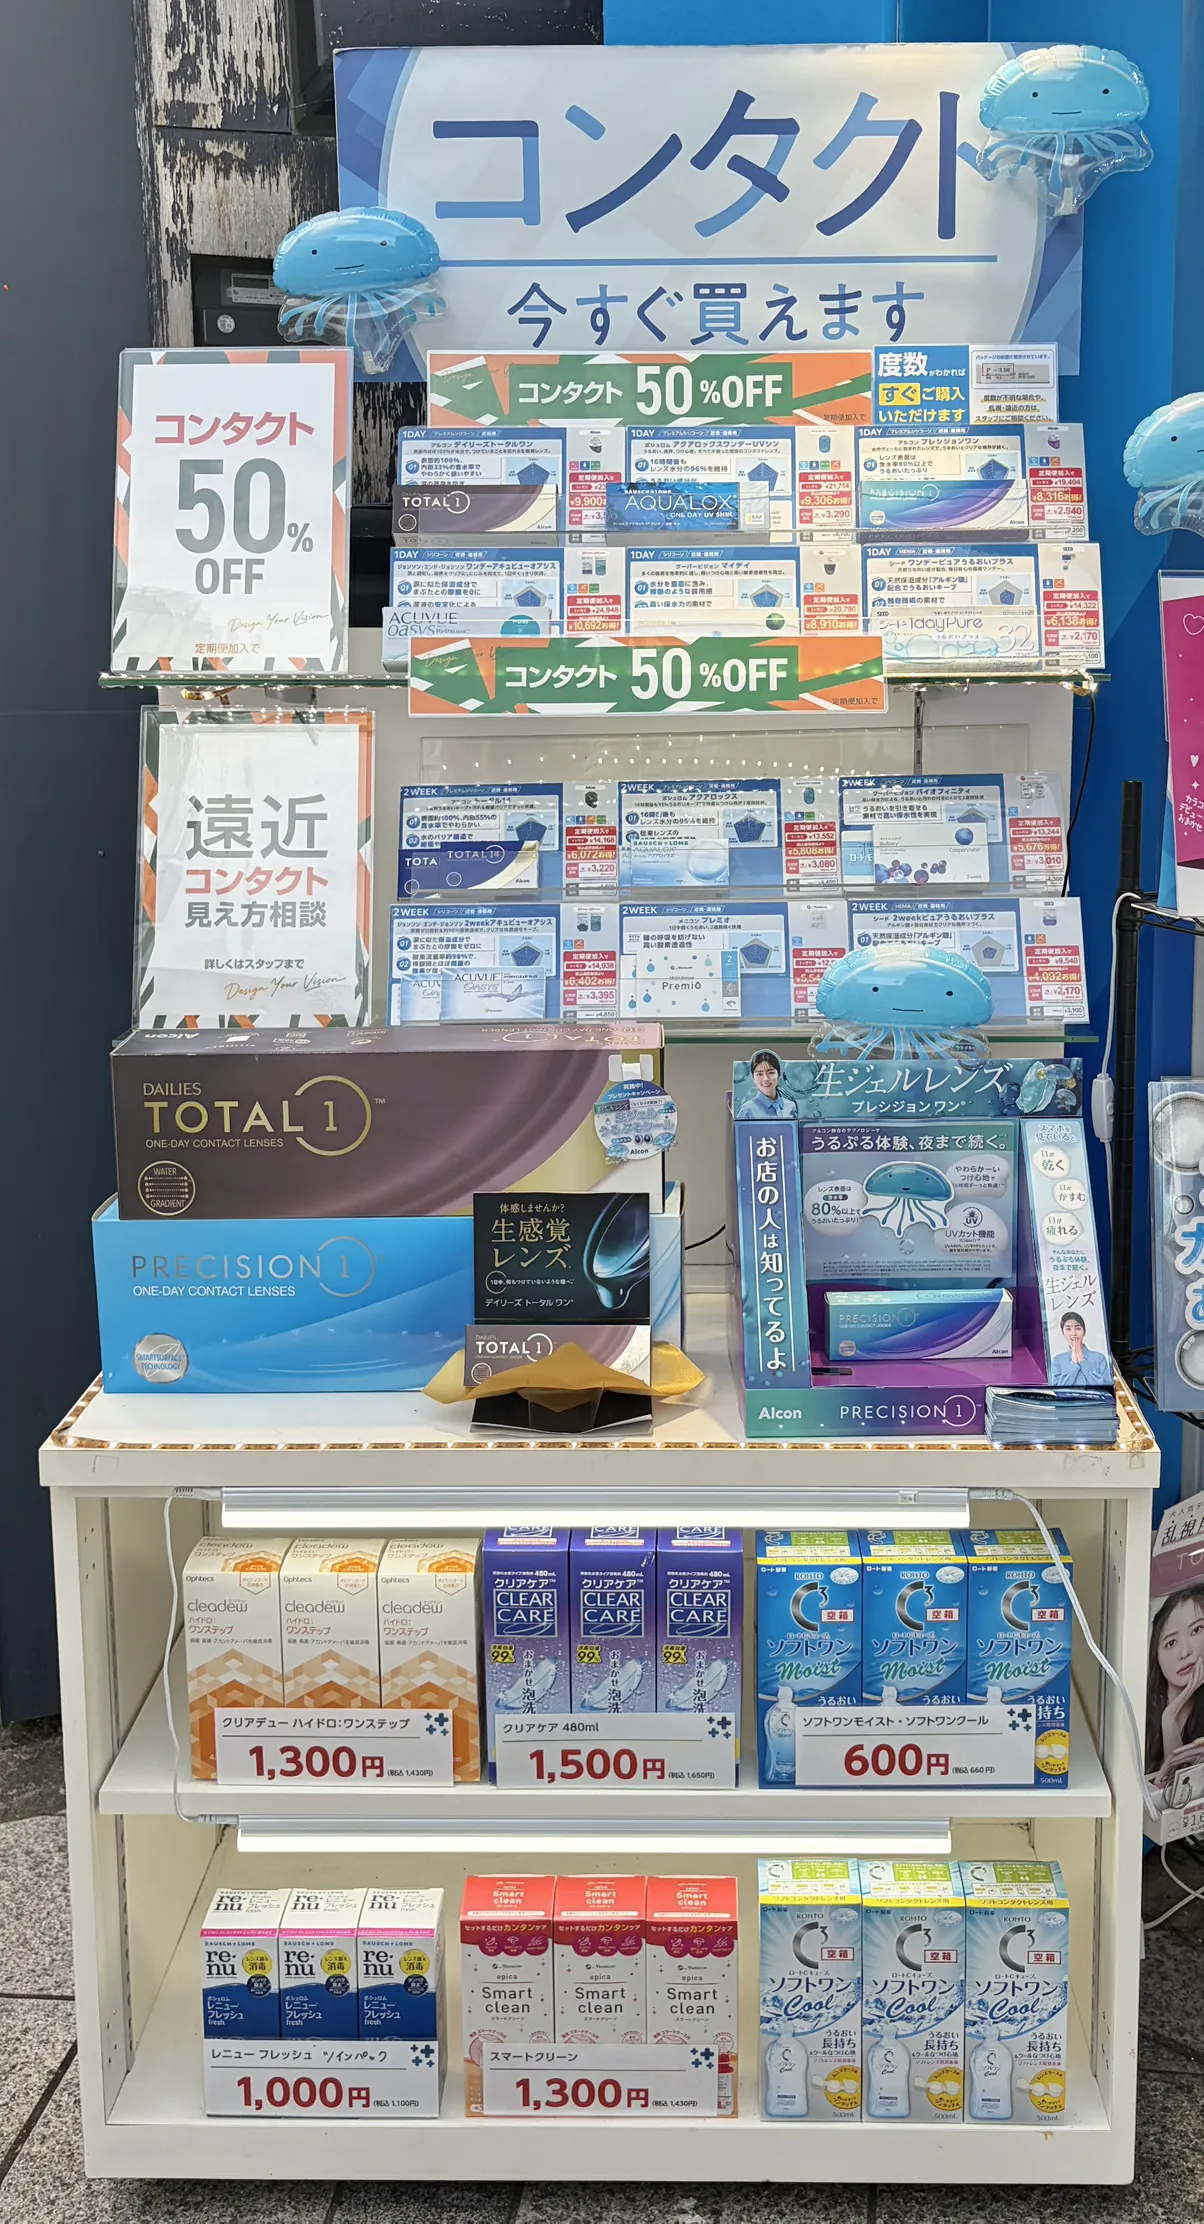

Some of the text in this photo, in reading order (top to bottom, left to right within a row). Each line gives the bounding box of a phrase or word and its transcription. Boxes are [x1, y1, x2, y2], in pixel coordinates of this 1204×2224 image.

[432, 89, 981, 240] コンタクト
[505, 280, 927, 346] 今すぐ買えます
[518, 379, 623, 405] コンタクト
[882, 385, 965, 402] すぐご購入
[878, 409, 965, 423] いただけます
[154, 411, 315, 446] コンタクト
[402, 430, 426, 438] 1DAY
[631, 429, 655, 437] 1DAY
[859, 428, 882, 436] 1DAY
[625, 495, 732, 510] AQUALOX
[394, 550, 419, 558] 1DAY
[630, 551, 654, 559] 1DAY
[867, 548, 891, 556] 1DAY
[908, 558, 1014, 566] ワンデーピュアうるおいプラス
[195, 557, 266, 595] OFF
[227, 610, 329, 633] Design Your Vision
[389, 612, 458, 624] ACUVUE
[999, 623, 1035, 653] 32
[194, 643, 260, 654] 定期便加入で
[505, 664, 617, 690] コンタクト
[404, 787, 437, 796] 2WEEK
[185, 793, 329, 860] 遠近
[185, 866, 329, 897] コンタクト
[393, 908, 429, 916] 2WEEK
[622, 906, 657, 914] 2WEEK
[852, 903, 888, 911] 2WEEK
[184, 901, 327, 929] 見え方相談
[893, 913, 995, 922] 2weekピュアうるおいプラス
[204, 958, 305, 970] 詳しくはスタッフまで
[454, 973, 500, 982] ACUVUE
[224, 974, 347, 1001] Design Your Vision
[811, 1061, 1013, 1099] 生ジェルレンズ
[143, 1082, 202, 1097] DAILIES
[851, 1101, 961, 1114] プレシジョン ワン
[143, 1101, 338, 1134] TOTAL 1
[1039, 1124, 1070, 1133] スマホを
[145, 1138, 284, 1148] ONE-DAY CONTACT LENSES
[811, 1134, 1007, 1151] うるぷる体験、夜まで続く。
[1036, 1132, 1077, 1142] 見ていると
[153, 1167, 177, 1176] WATER
[1041, 1159, 1066, 1171] 乾く
[150, 1199, 185, 1208] GRADIENT
[1059, 1192, 1086, 1202] かすむ
[499, 1203, 565, 1213] 体感しませんか?
[811, 1216, 860, 1225] うるおいたっぷり!
[491, 1218, 571, 1243] 生感覚
[945, 1229, 996, 1239] UVカット機能
[1046, 1225, 1079, 1237] 疲れる
[493, 1243, 572, 1269] レンズ
[756, 1136, 787, 1370] お店の人は知ってるよ
[131, 1255, 349, 1279] PRECISION 1
[133, 1285, 296, 1297] ONE-DAY CONTACT LENSES
[1045, 1275, 1097, 1295] 生ジェル
[485, 1298, 522, 1307] デイリーズ
[525, 1298, 553, 1307] トータル
[1051, 1290, 1097, 1311] レンズ
[758, 1406, 802, 1420] Alcon
[840, 1404, 947, 1420] PRECISION
[185, 1575, 215, 1583] Ophtecs
[494, 1578, 549, 1589] クリアケア
[496, 1592, 553, 1606] CLEAR
[583, 1592, 640, 1606] CLEAR
[187, 1601, 248, 1613] cleadew
[497, 1609, 553, 1622] CARE
[584, 1609, 640, 1622] CARE
[825, 1610, 850, 1620] 空箱
[189, 1625, 234, 1636] ワンステップ
[768, 1639, 853, 1656] ソフトワン
[872, 1639, 957, 1656] ソフトワン
[977, 1638, 1062, 1655] ソフトワン
[777, 1659, 840, 1680] Moist
[881, 1659, 944, 1680] Moist
[986, 1659, 1050, 1680] Moist
[222, 1717, 411, 1730] クリアデュー ハイドロ:ワンステップ
[503, 1722, 599, 1733] クリアケア 480ml
[803, 1715, 989, 1727] ソフトワンモイスト・ソフトワンクール
[248, 1744, 384, 1780] 1,300円
[405, 1769, 434, 1777] 1,430円)
[529, 1748, 666, 1784] 1,500円
[844, 1743, 949, 1776] 600円
[827, 1949, 848, 1960] 空箱
[206, 1963, 237, 1976] nu
[248, 1962, 267, 1971] 消毒
[770, 1977, 852, 1992] ソフトワン
[873, 1978, 955, 1994] ソフトワン
[976, 1980, 1058, 1996] ソフトワン
[482, 1987, 533, 1999] Smart
[485, 2001, 530, 2014] clean
[578, 2001, 623, 2014] clean
[784, 1995, 834, 2018] Cool
[886, 1997, 936, 2020] Cool
[989, 1998, 1039, 2020] Cool
[826, 2030, 856, 2038] うるおい
[822, 2038, 856, 2049] 長持ち
[211, 2050, 388, 2063] レニュー フレッシュ ツインパック
[490, 2052, 578, 2062] スマートクリーン
[236, 2076, 370, 2111] 1,000円
[516, 2078, 649, 2110] 1,300円
